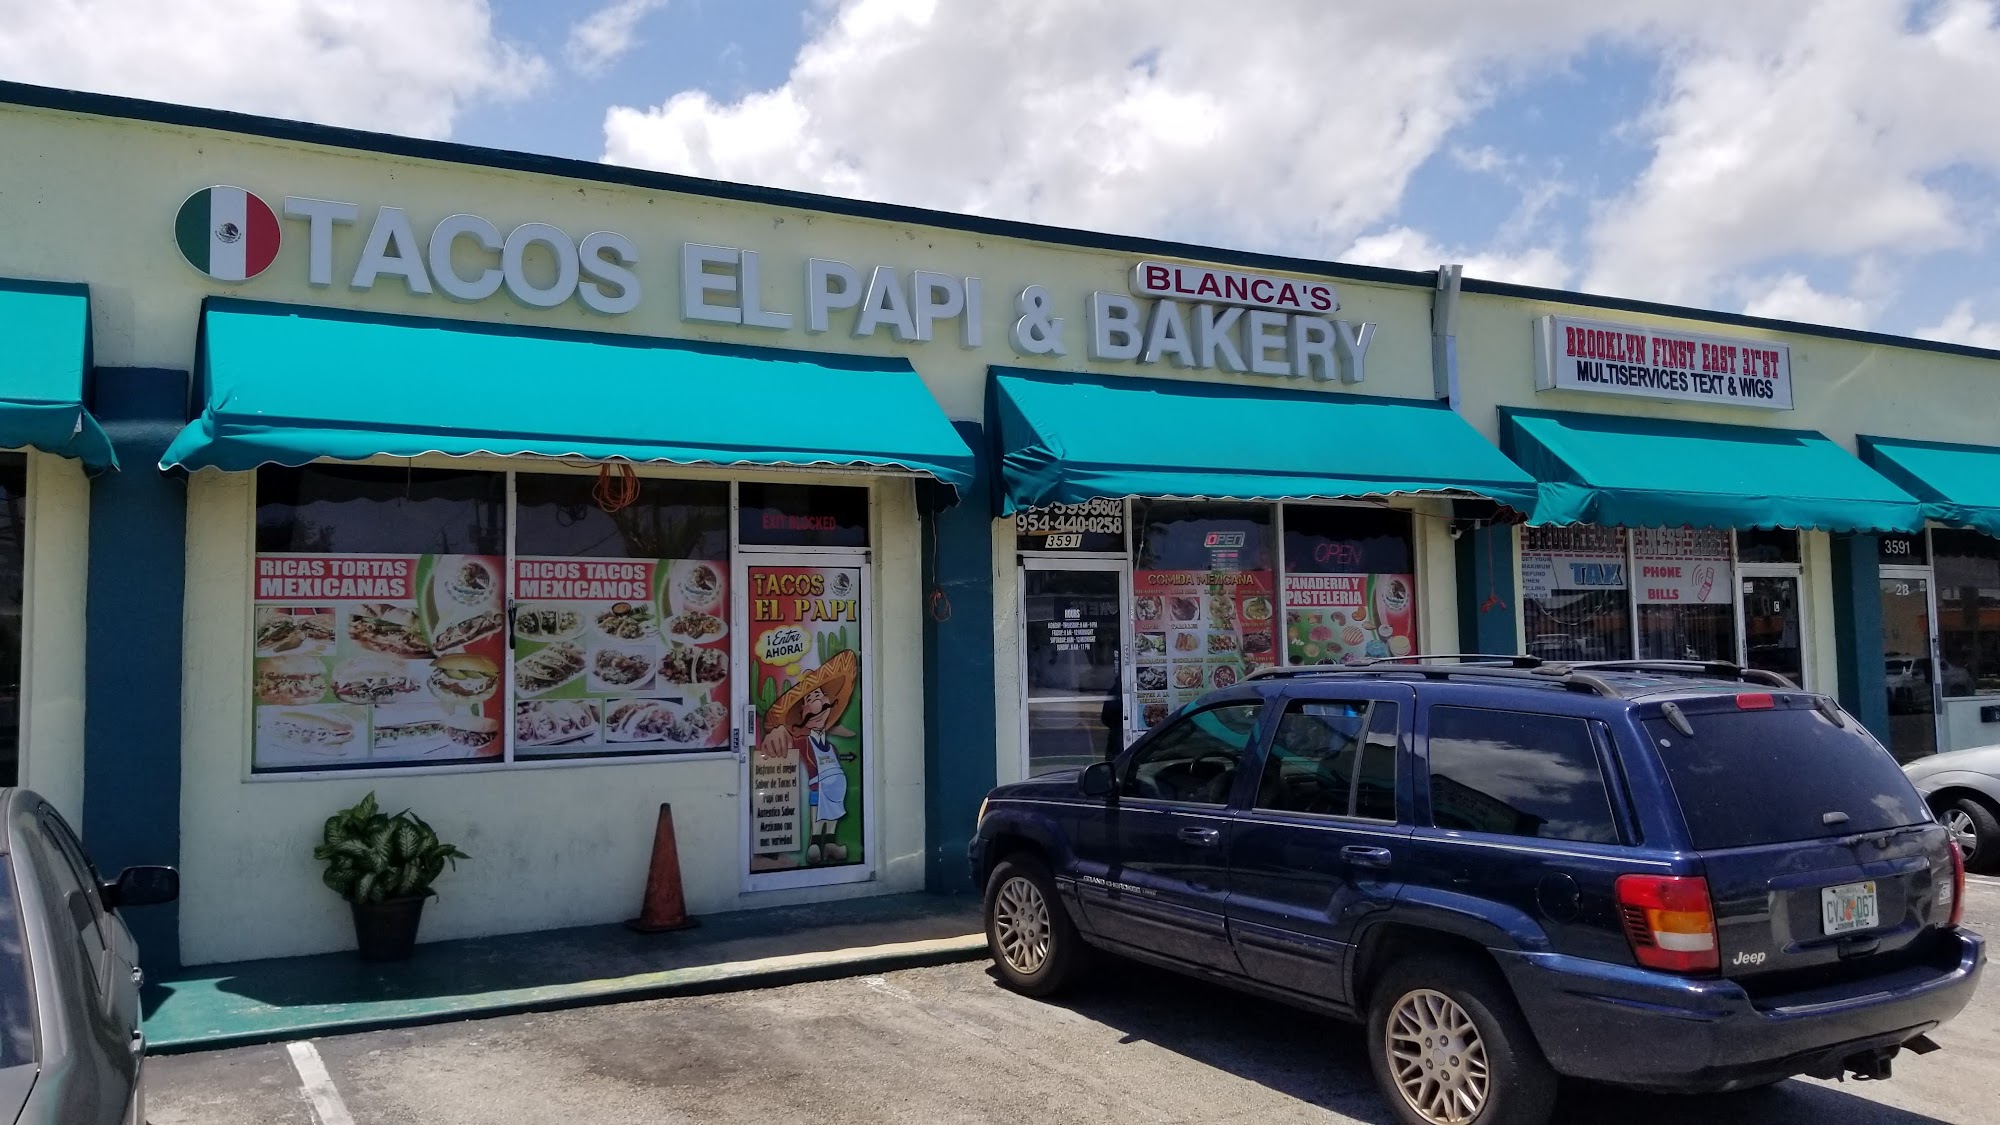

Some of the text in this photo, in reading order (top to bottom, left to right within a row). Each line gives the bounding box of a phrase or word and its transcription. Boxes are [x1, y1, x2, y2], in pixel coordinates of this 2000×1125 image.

[284, 196, 1377, 383] TACOS EL PAPI & BAKERY
[1146, 265, 1331, 311] BLANCA'S
[1566, 326, 1646, 365] BROOKLYN
[1652, 337, 1696, 371] FINST
[1701, 343, 1737, 374] EAST
[1577, 361, 1773, 399] MULTISERVICES TEXT & WIGS
[762, 512, 836, 531] EXIT BLOCKED
[1048, 535, 1079, 547] 3591
[1207, 534, 1242, 546] OPEN
[1884, 540, 1911, 554] 3591
[1315, 543, 1361, 565] OPEN
[260, 560, 407, 576] RICAS TORTAS
[519, 562, 646, 580] RICOS TACOS
[1569, 562, 1623, 586] TAX
[1643, 566, 1682, 578] PHONE
[260, 578, 406, 597] MEXICANAS
[753, 573, 824, 597] TACOS
[1147, 574, 1255, 586] COMIDA MEXICANA
[1285, 577, 1360, 590] PANADERIA Y
[519, 580, 646, 599] MEXICANOS
[1285, 590, 1363, 605] PASTELERIA
[1648, 588, 1679, 600] BILLS
[1895, 583, 1909, 596] 2B
[754, 599, 857, 622] EL PAPI
[766, 643, 803, 659] AHORA!
[770, 778, 776, 789] de
[1084, 875, 1105, 885] GRAND
[1105, 880, 1141, 894] CHEROKEE
[1732, 951, 1766, 966] Jeep
